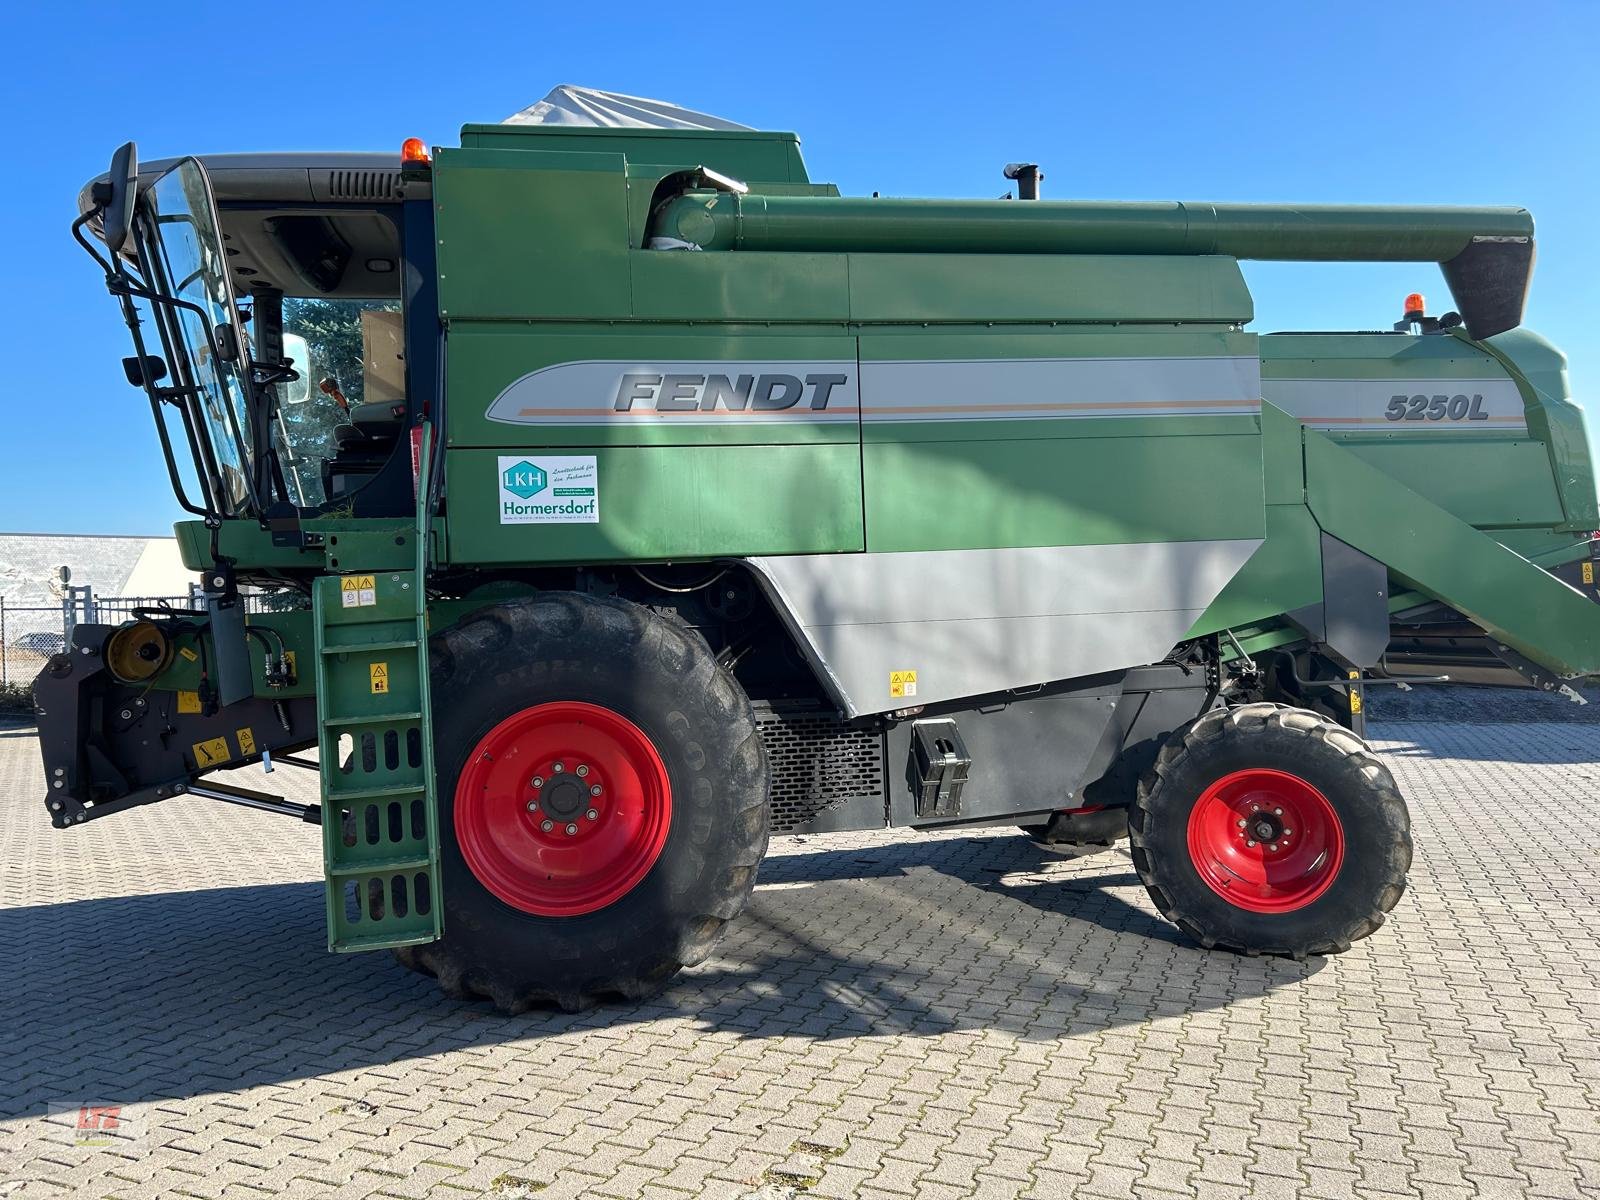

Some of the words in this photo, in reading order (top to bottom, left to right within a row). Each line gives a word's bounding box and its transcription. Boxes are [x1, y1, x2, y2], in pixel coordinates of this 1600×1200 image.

[613, 374, 848, 412] FENDT
[1384, 394, 1489, 421] 5250L
[504, 472, 542, 487] LKH
[503, 500, 595, 515] Hormersdorf
